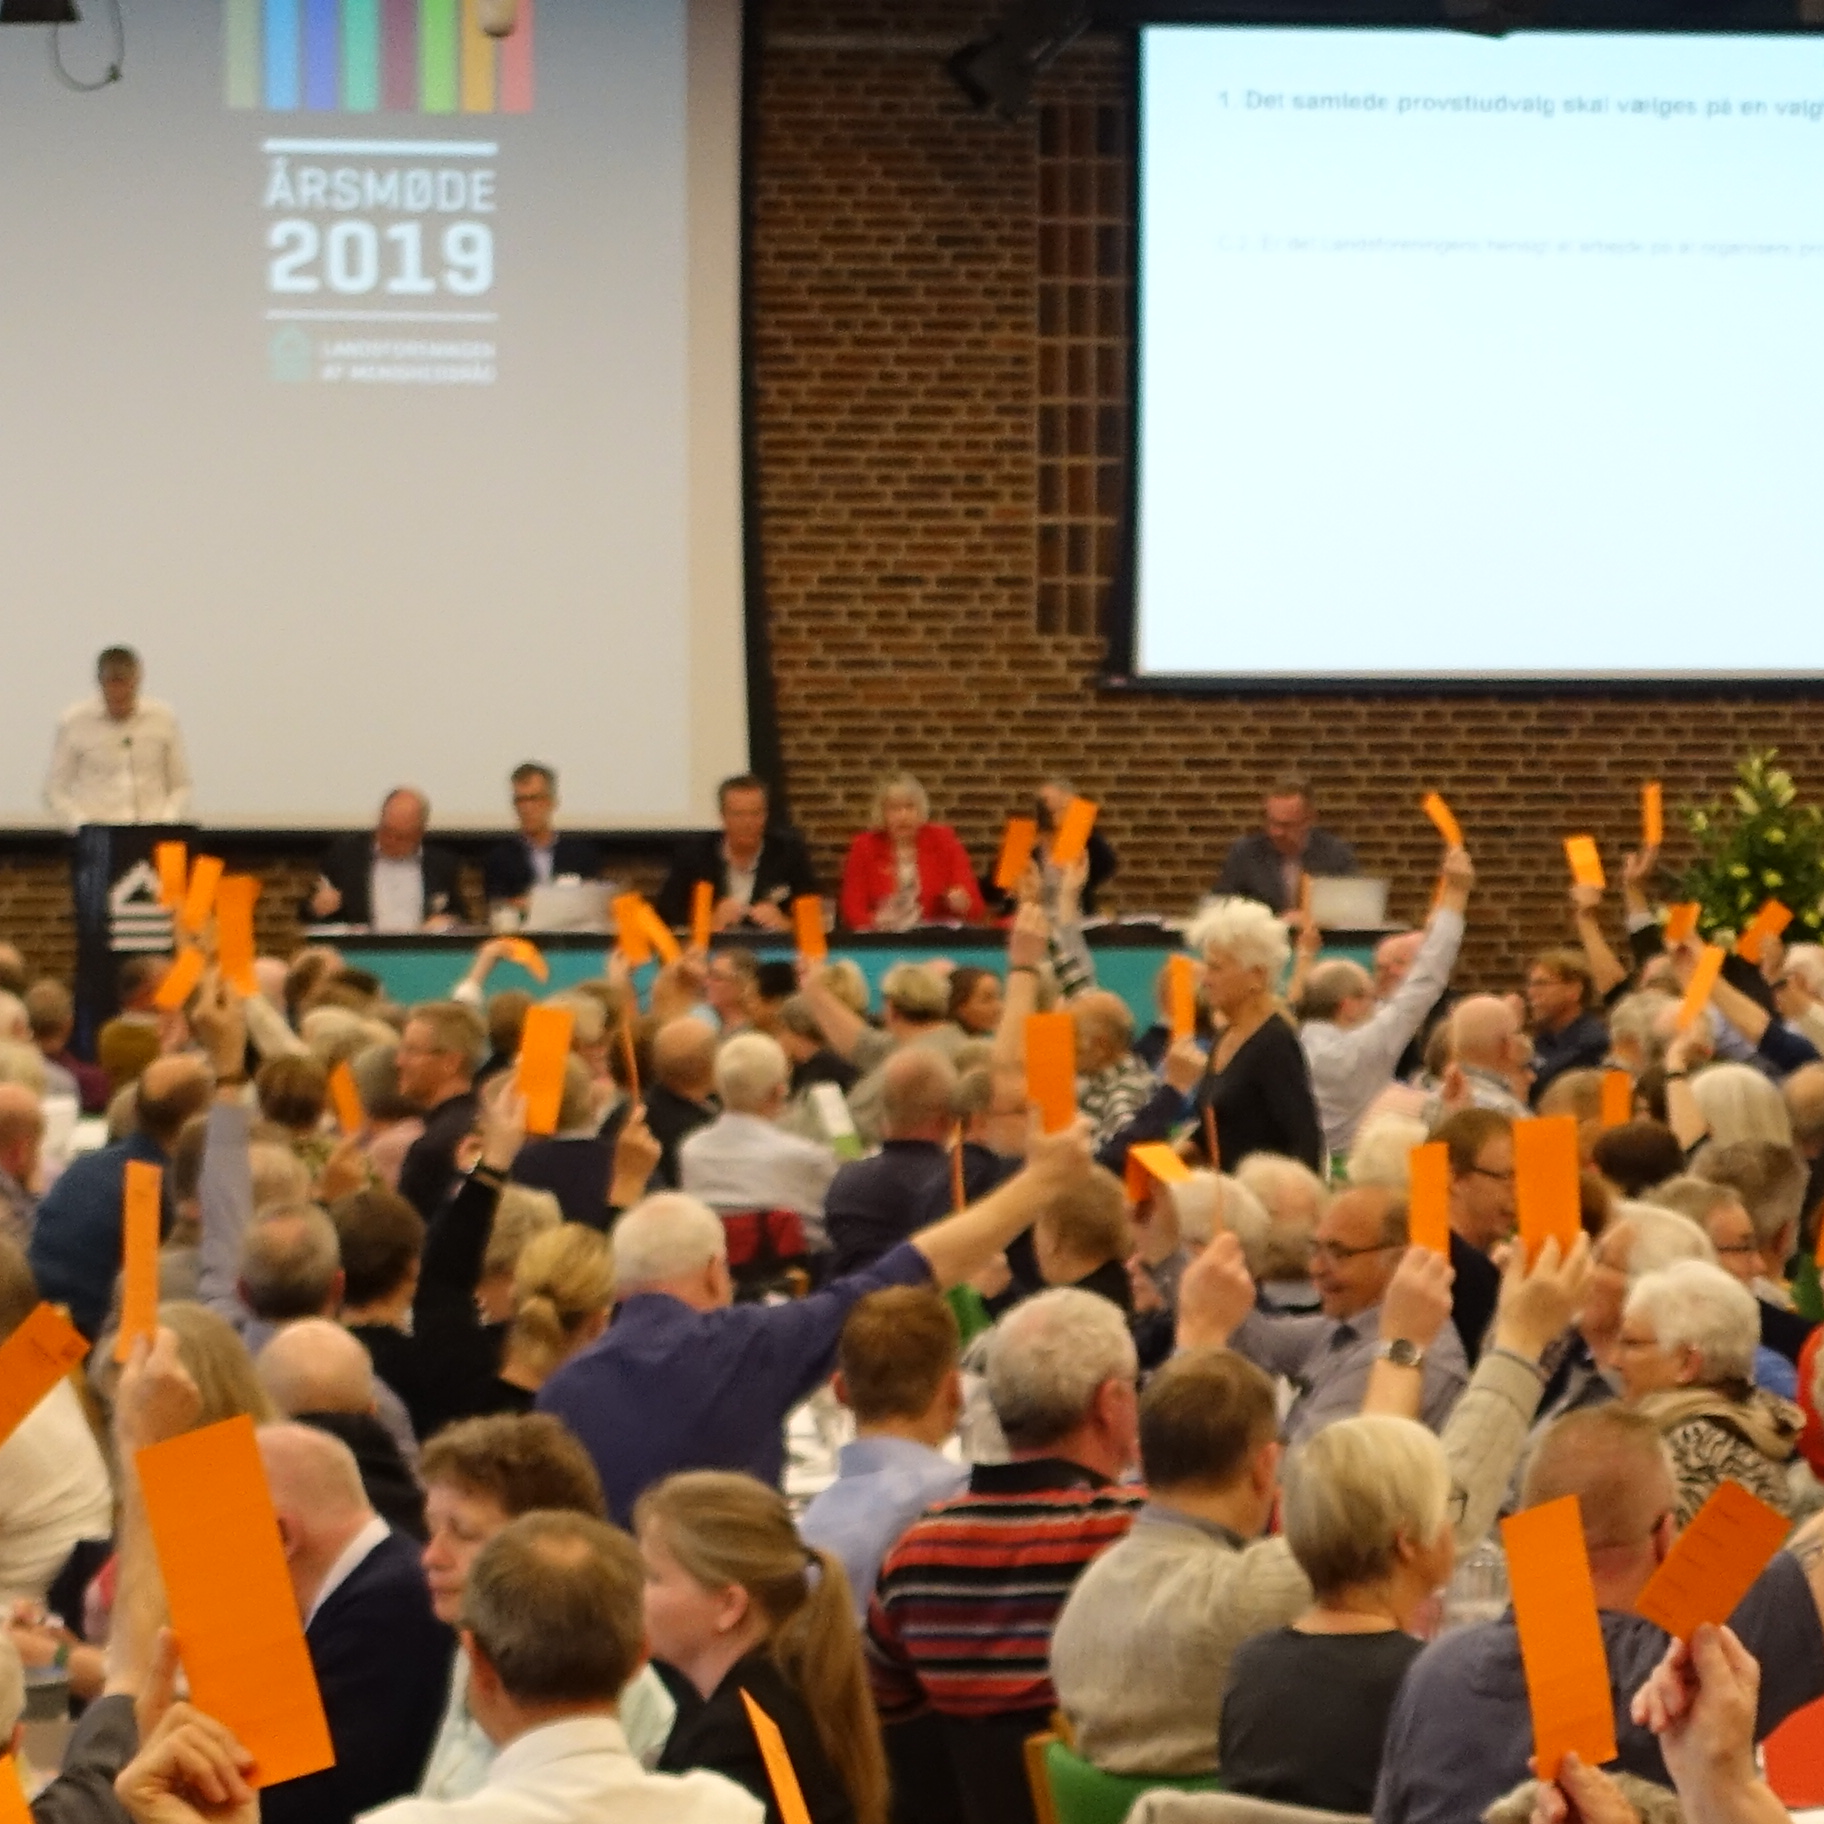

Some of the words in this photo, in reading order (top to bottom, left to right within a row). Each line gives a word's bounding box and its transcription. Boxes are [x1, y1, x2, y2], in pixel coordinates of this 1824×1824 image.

[1243, 88, 1284, 110] Det
[1291, 91, 1389, 112] samlede
[1395, 93, 1556, 119] provstiudvalg
[1562, 95, 1610, 114] skal
[1704, 96, 1733, 118] på
[1738, 99, 1768, 116] en
[265, 156, 497, 211] ÅRSMØDE
[269, 218, 494, 295] 2019
